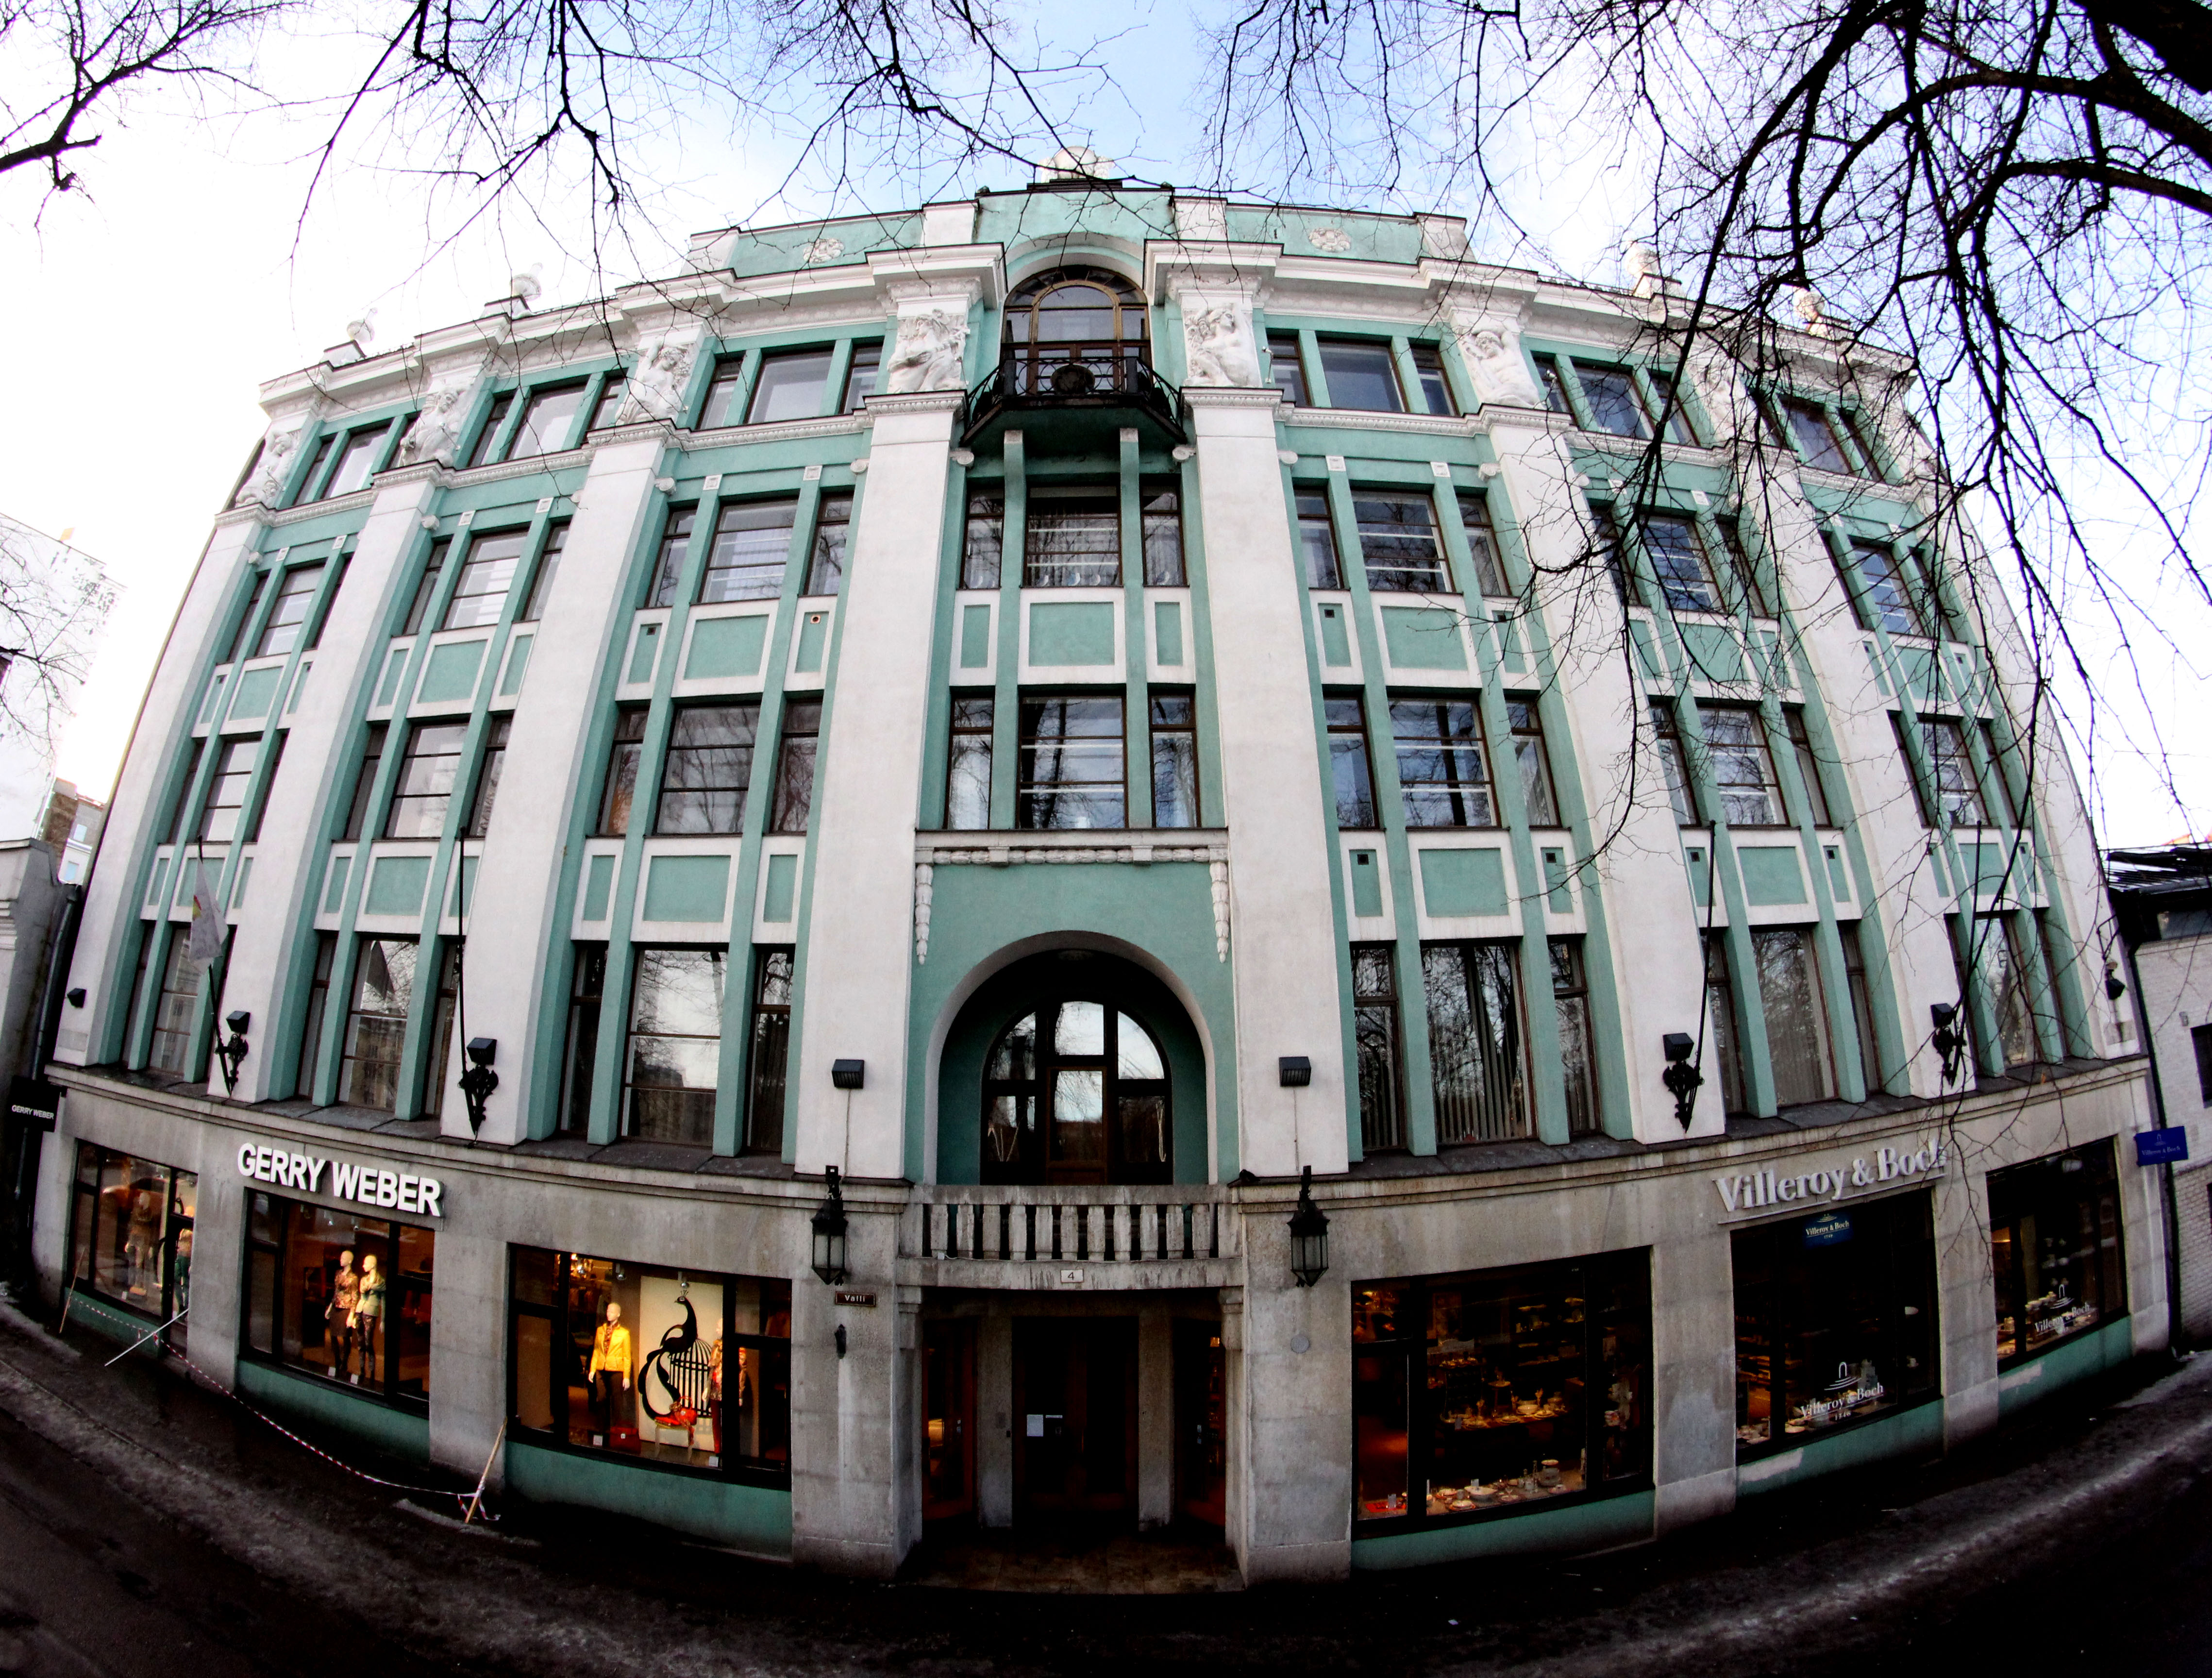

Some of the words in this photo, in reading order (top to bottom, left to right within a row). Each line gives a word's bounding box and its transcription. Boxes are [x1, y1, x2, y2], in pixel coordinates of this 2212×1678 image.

[12, 1105, 33, 1115] GERRY
[33, 1109, 54, 1120] WEBER
[237, 1142, 326, 1192] GERRY
[332, 1161, 441, 1217] WEBER
[1712, 1167, 1846, 1212] Villeroy
[1852, 1158, 1874, 1187] &
[1875, 1138, 1947, 1182] Boch
[1806, 1226, 1829, 1235] Villeroy
[1835, 1220, 1850, 1229] Boch
[1067, 1272, 1074, 1280] 4
[844, 1294, 865, 1302] Valli
[1800, 1397, 1845, 1417] Villeroy
[1857, 1382, 1884, 1401] Boch
